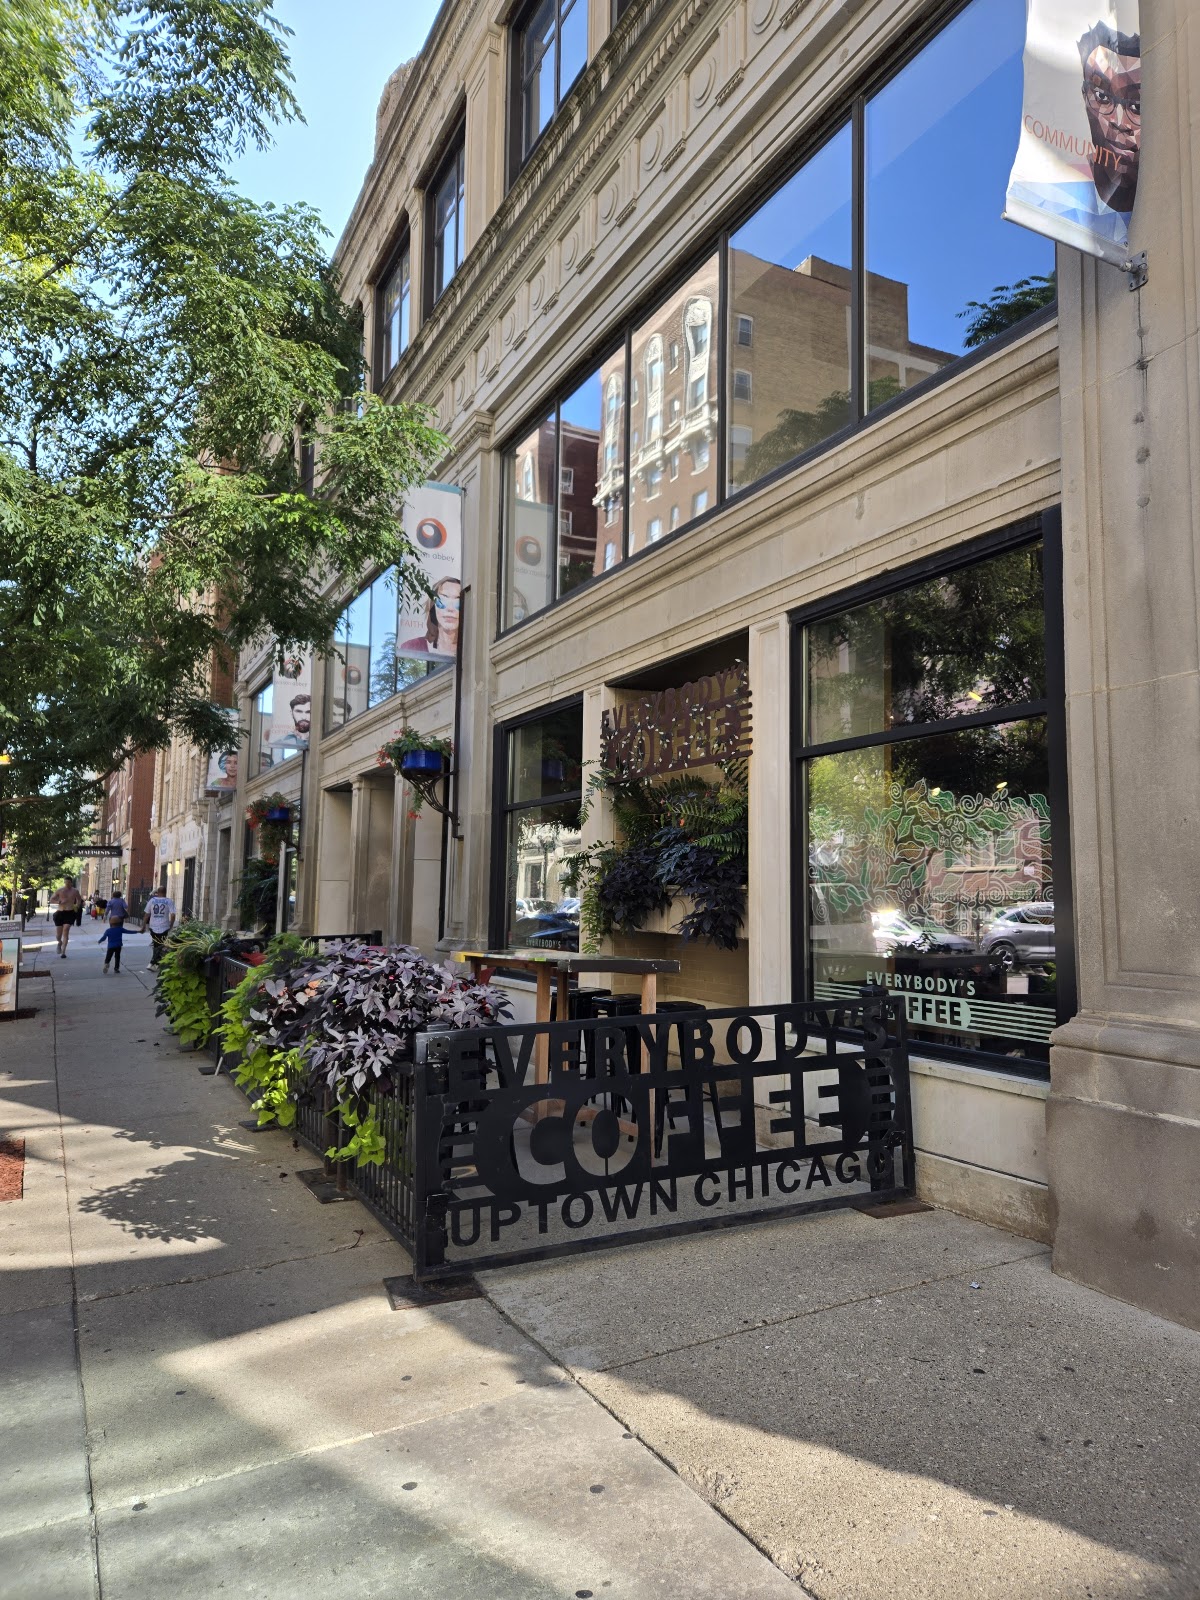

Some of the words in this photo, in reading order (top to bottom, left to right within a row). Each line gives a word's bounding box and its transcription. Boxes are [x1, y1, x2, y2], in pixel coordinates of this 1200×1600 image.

[1024, 115, 1123, 171] COMMUNITY
[432, 552, 455, 563] abbey
[400, 618, 424, 629] FAITH
[866, 970, 976, 996] EVERYBODY'S
[888, 995, 962, 1027] FFEE
[453, 1012, 888, 1093] EVERYBODY'S
[511, 1067, 843, 1186] COFFEE
[449, 1176, 678, 1247] UPTOWN
[694, 1147, 894, 1207] CHICAGO
